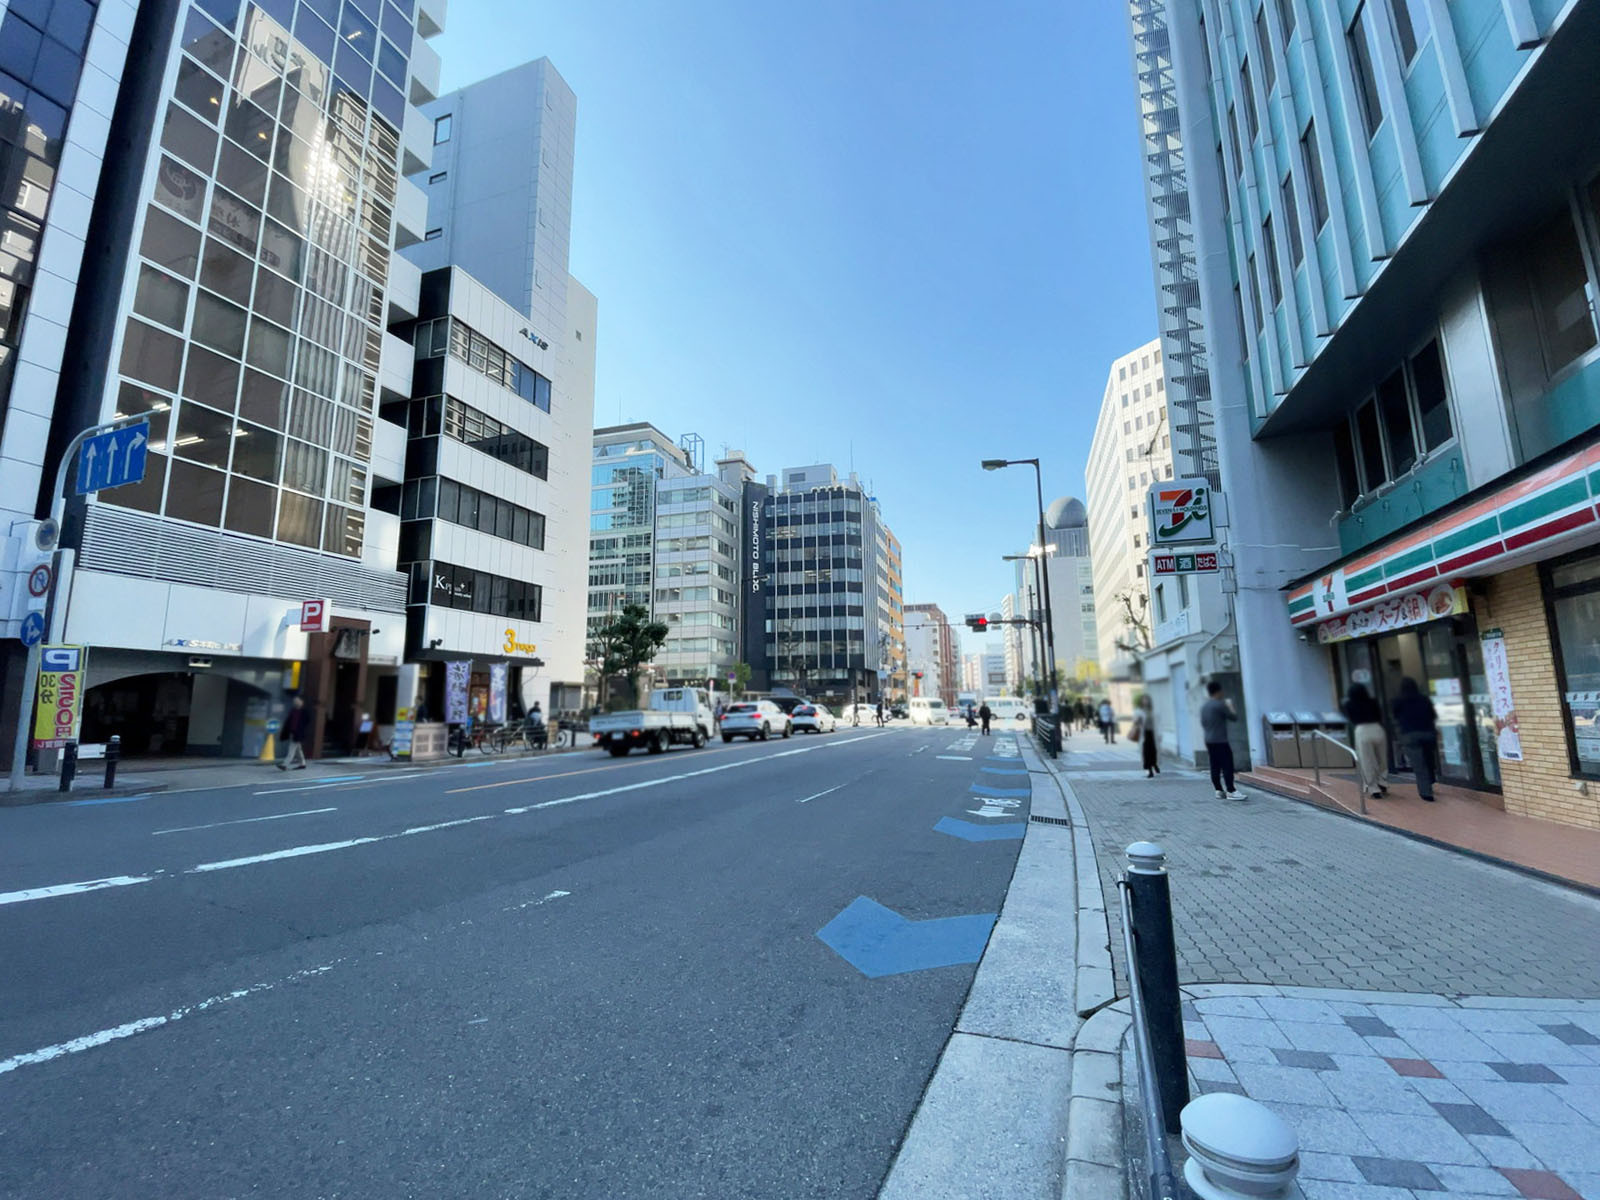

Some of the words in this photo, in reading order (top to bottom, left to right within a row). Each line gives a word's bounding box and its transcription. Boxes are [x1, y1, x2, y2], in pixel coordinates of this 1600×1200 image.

[518, 327, 549, 351] AXIS
[752, 501, 760, 560] NISHIMOTO
[1156, 557, 1175, 571] ATM
[303, 602, 321, 623] P
